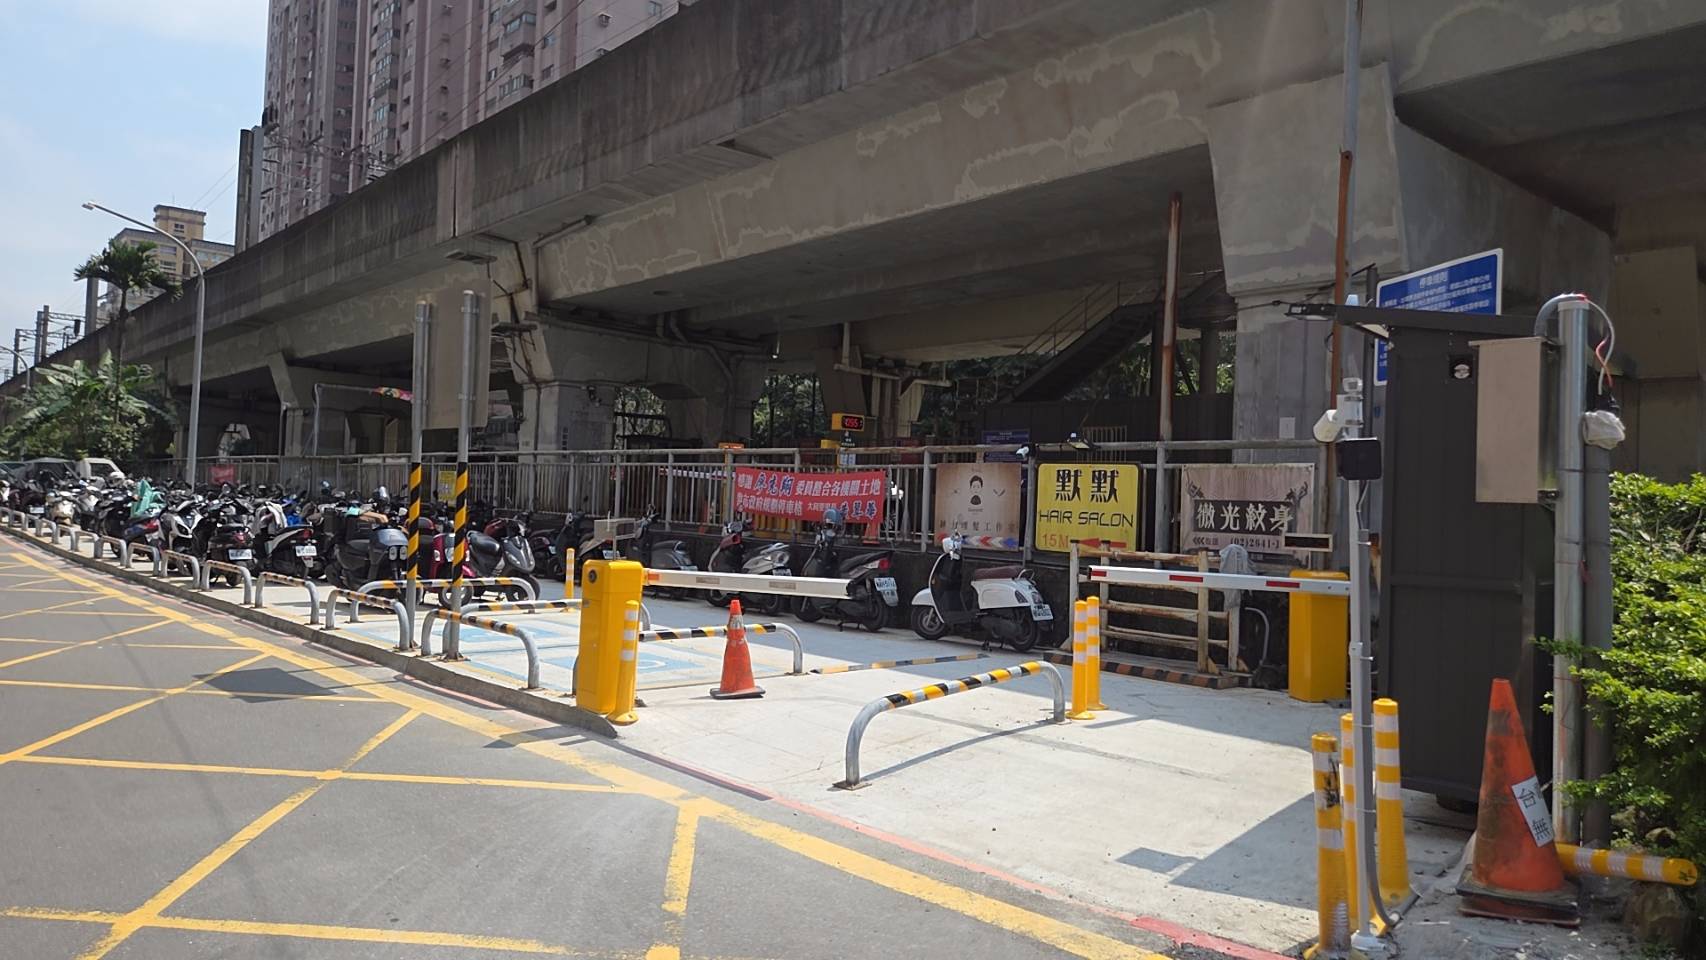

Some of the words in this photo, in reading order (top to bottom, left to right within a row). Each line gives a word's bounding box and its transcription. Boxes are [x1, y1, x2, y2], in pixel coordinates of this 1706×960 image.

[1055, 469, 1119, 503] 默默
[1039, 509, 1073, 524] HAIR
[1077, 511, 1135, 528] SALON
[1042, 533, 1069, 549] 15M
